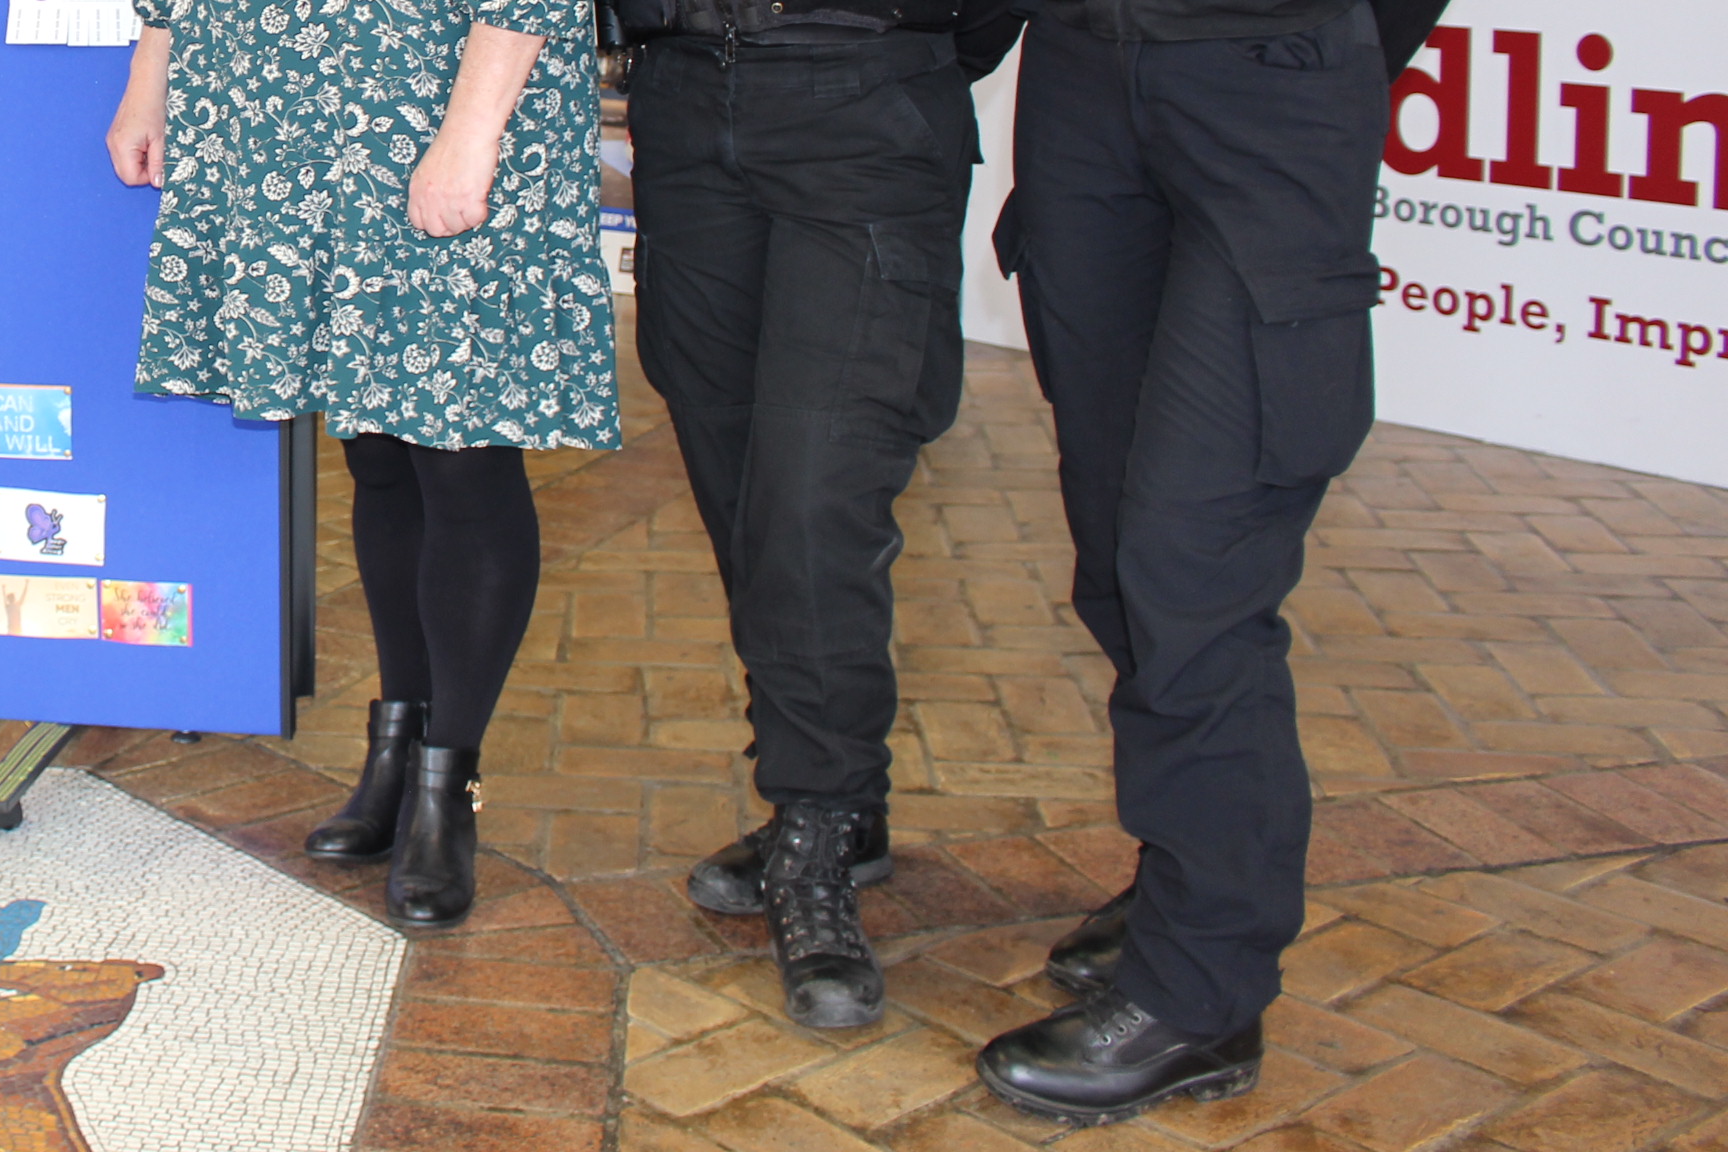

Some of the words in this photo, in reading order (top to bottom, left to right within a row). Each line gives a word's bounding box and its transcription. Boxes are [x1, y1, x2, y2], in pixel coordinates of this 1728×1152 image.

[1372, 185, 1554, 247] Borough
[1378, 265, 1566, 344] People,
[5, 434, 62, 454] WILL
[114, 587, 131, 602] She
[137, 590, 178, 605] believed
[55, 604, 80, 613] MEN
